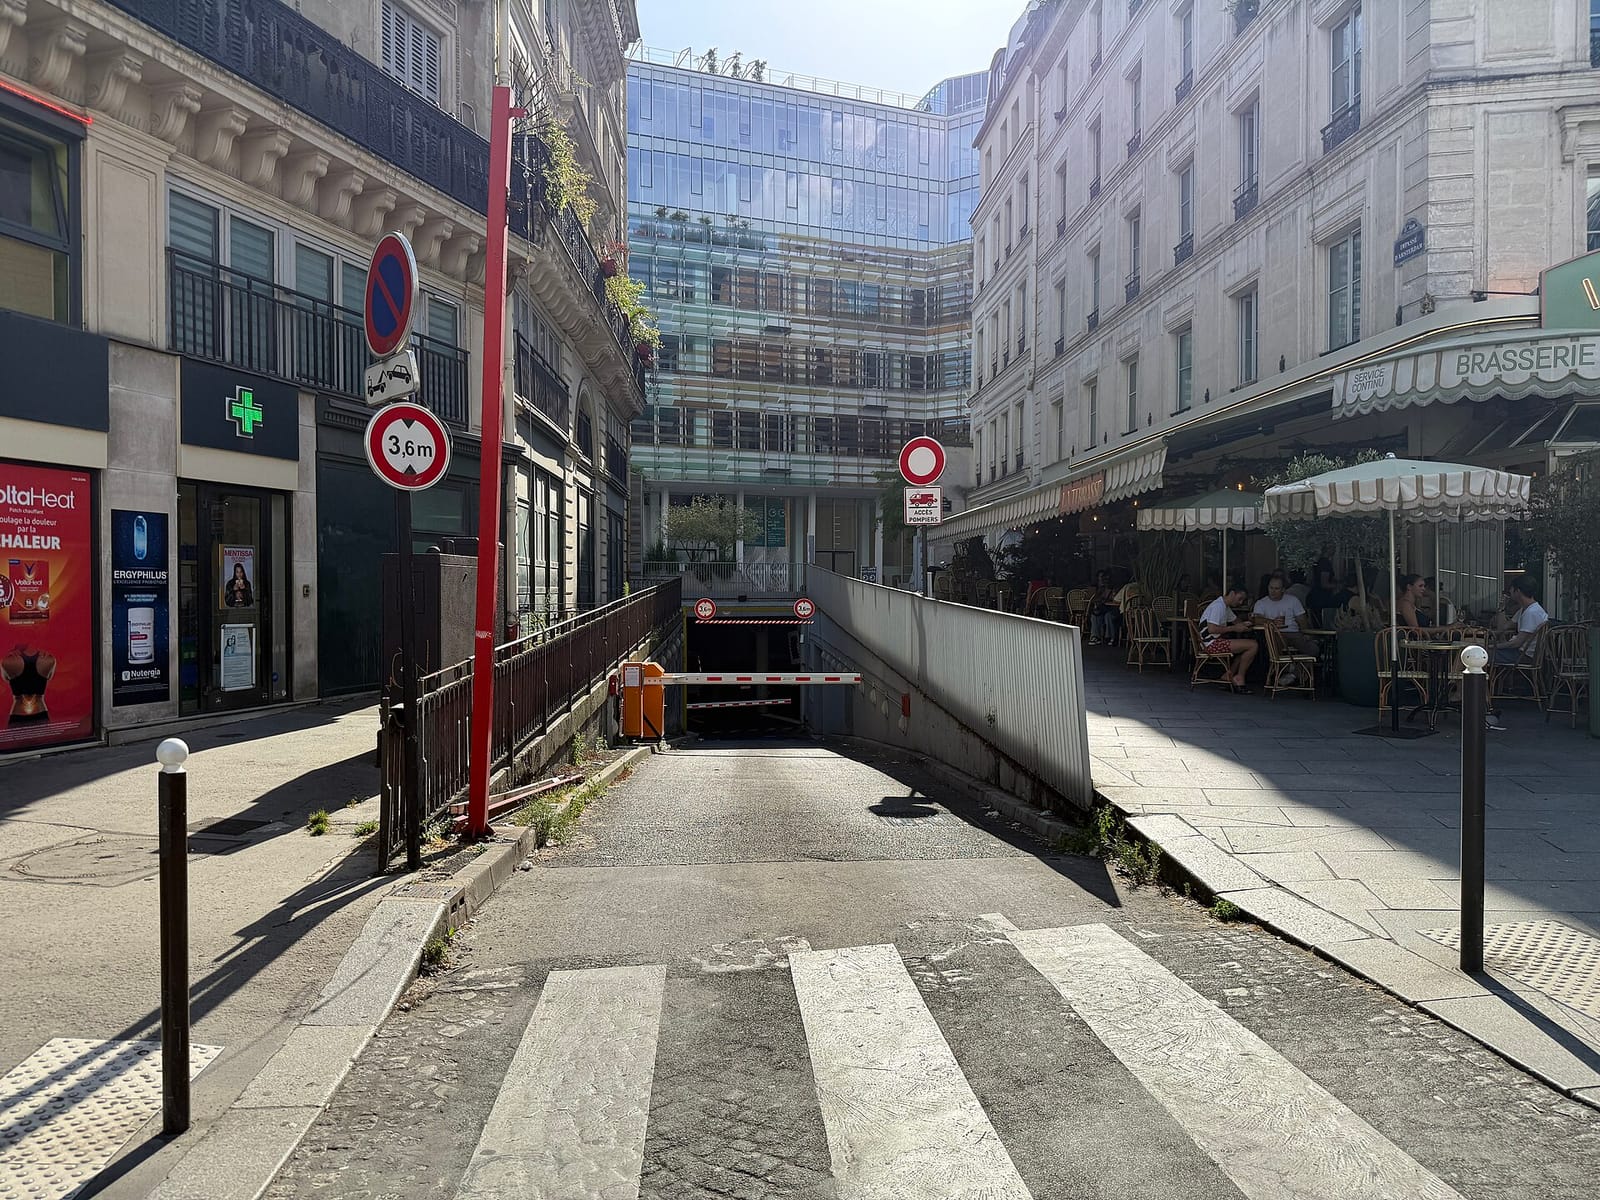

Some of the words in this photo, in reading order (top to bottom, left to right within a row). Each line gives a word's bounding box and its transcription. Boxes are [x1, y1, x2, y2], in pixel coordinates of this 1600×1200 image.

[1456, 343, 1596, 375] BRASSERIE
[1354, 367, 1385, 383] SERVICE
[1351, 377, 1385, 393] CONTINU
[24, 517, 31, 525] la
[31, 518, 57, 526] douleur
[17, 526, 28, 534] par
[0, 534, 61, 550] HALEUR
[131, 667, 160, 678] Nutergia
